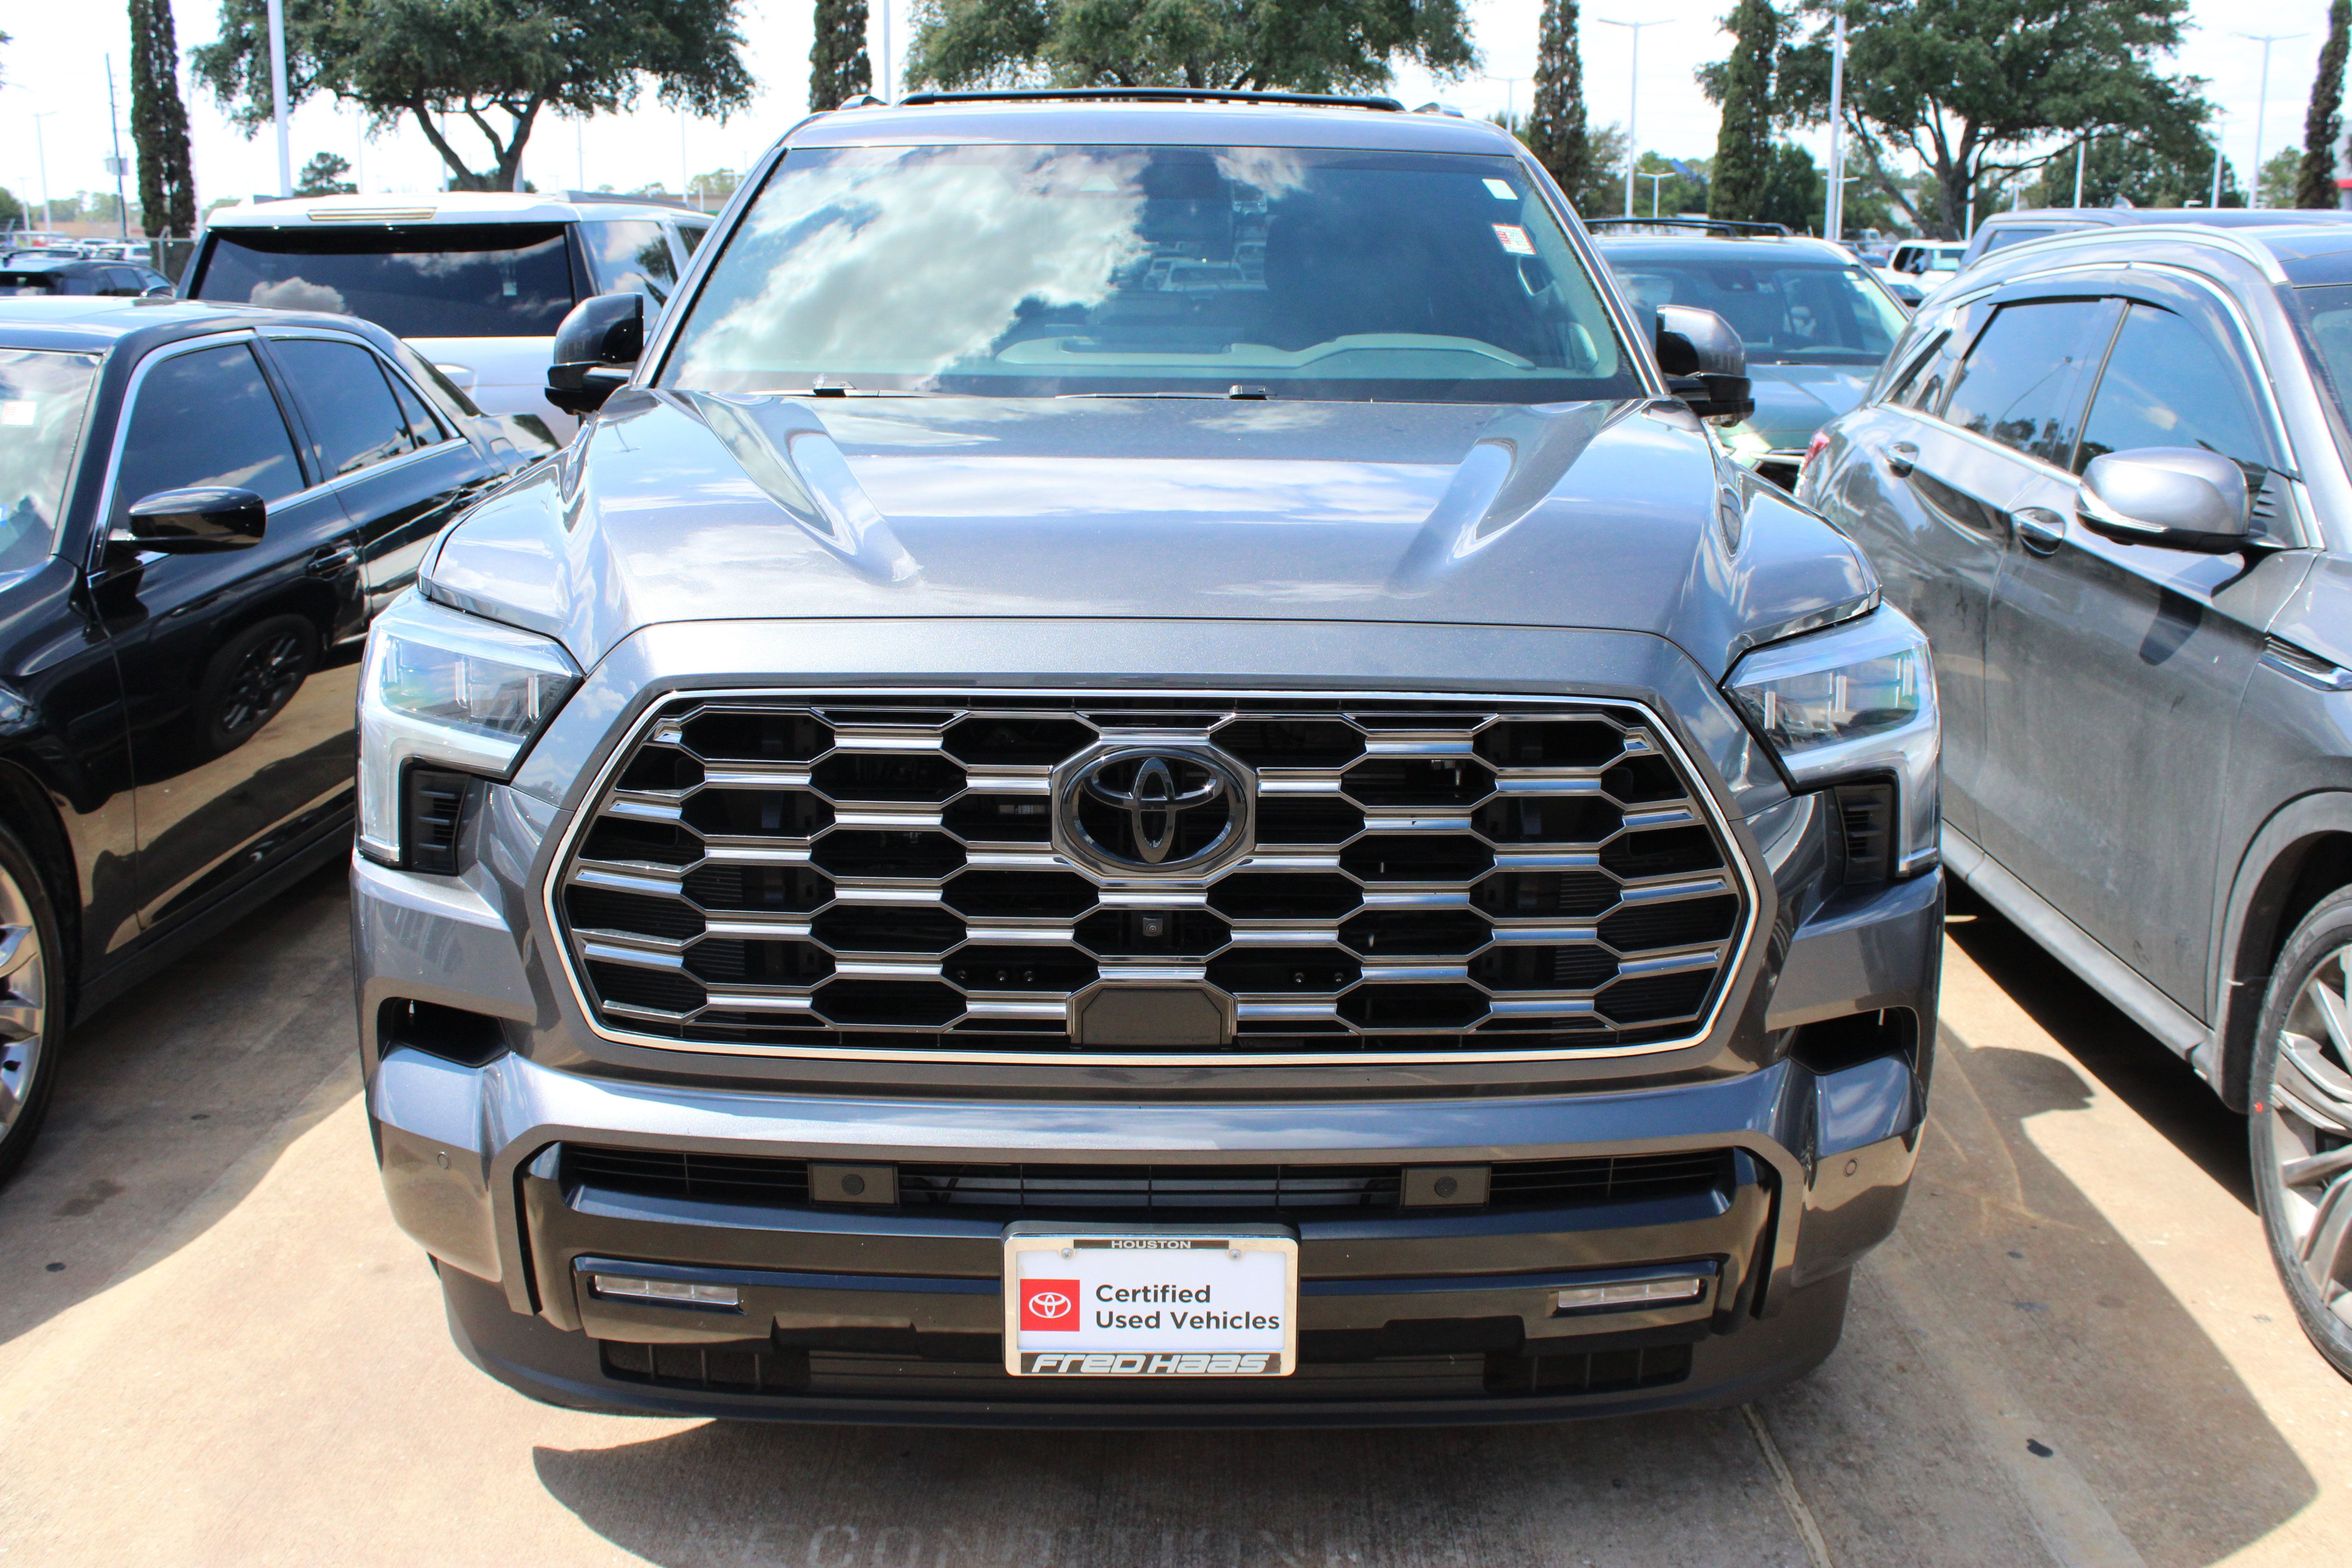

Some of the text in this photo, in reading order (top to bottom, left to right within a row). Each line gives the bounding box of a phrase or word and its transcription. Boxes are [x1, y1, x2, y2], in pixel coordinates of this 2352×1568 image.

[1111, 1241, 1191, 1249] HOUSTON
[1096, 1285, 1210, 1303] Certified
[1096, 1311, 1279, 1330] Used Vehicles
